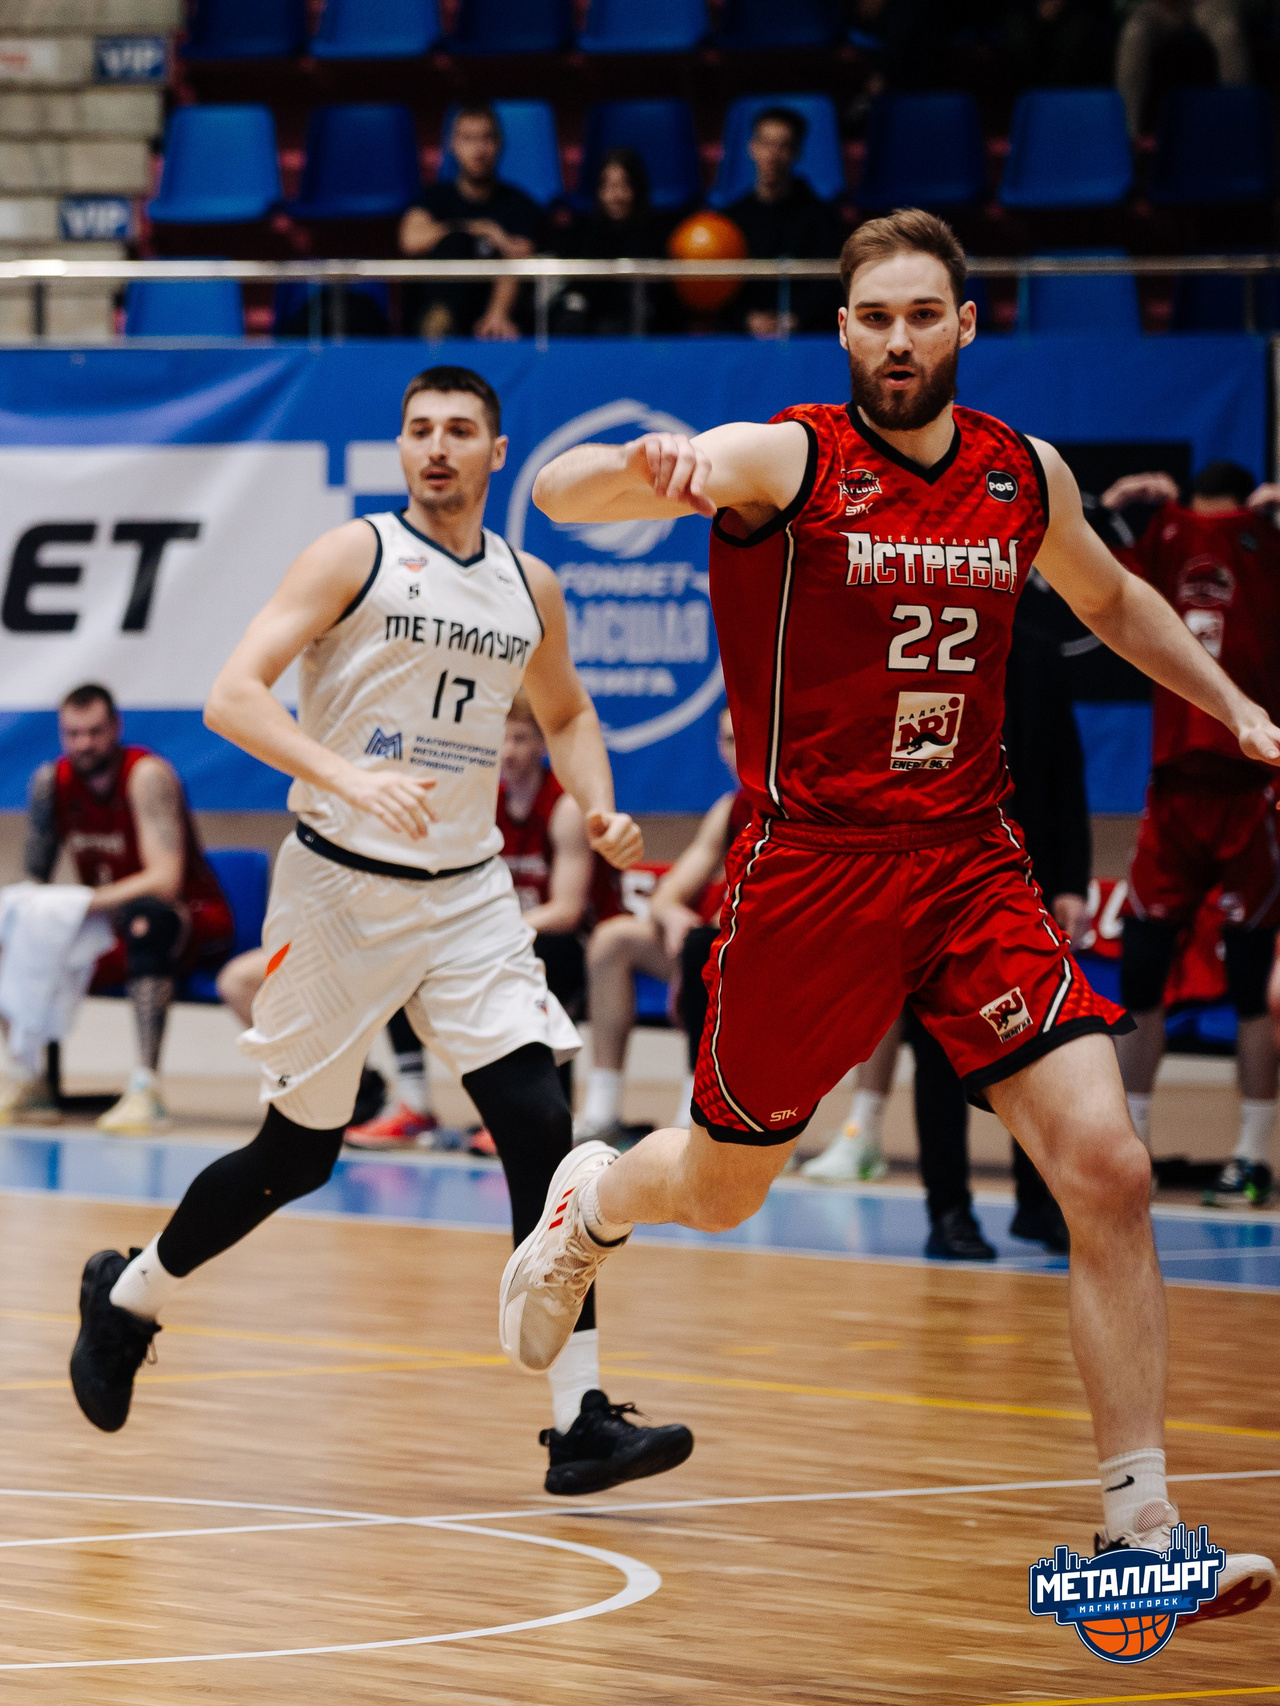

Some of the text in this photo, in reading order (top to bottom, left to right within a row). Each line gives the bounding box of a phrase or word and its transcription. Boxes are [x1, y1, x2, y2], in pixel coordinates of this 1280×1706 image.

[102, 46, 162, 73] VIP
[66, 203, 128, 235] VIP
[988, 481, 1014, 492] РФБ
[874, 534, 985, 547] ЧЕБОКСАРЫ
[838, 530, 1020, 595] ЯСТРЕБЫ
[385, 615, 531, 668] МЕТАЛЛУРГ
[568, 600, 709, 664] ЫСШАЯ
[887, 604, 979, 672] 22
[432, 670, 475, 723] 17
[899, 705, 946, 722] РАДИО
[895, 697, 960, 752] NRJ
[770, 1107, 798, 1121] STK
